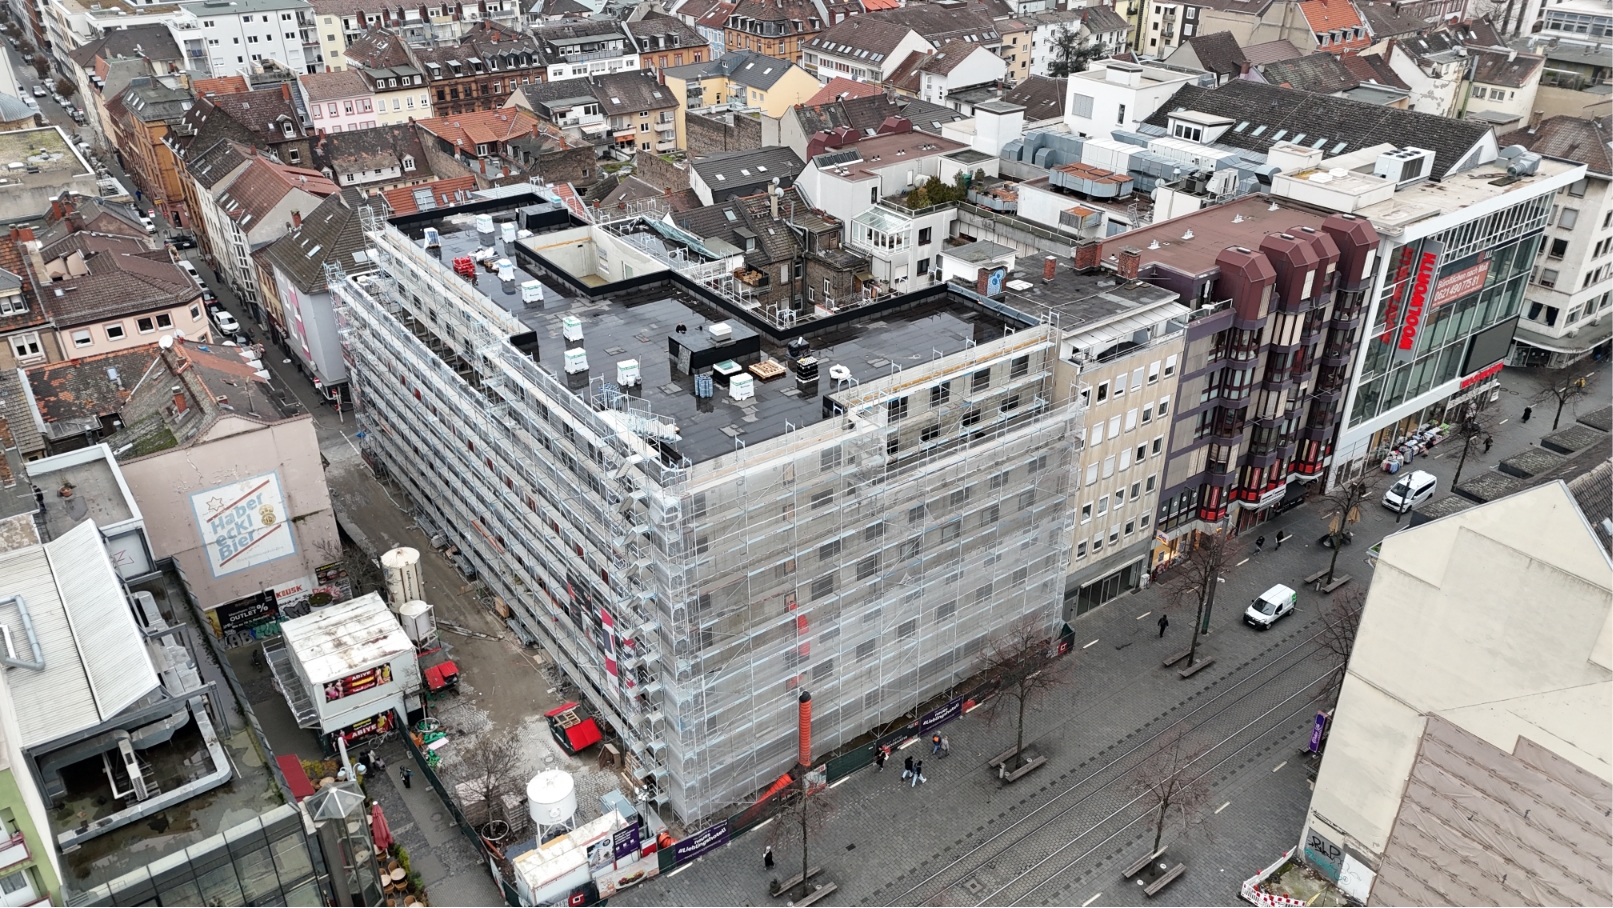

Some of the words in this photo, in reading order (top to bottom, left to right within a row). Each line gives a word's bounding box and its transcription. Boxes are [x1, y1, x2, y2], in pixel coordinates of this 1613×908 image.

[1399, 252, 1437, 350] WOOLWORTH
[211, 492, 263, 535] Haber
[216, 513, 253, 547] eckl
[219, 531, 255, 561] Bier
[230, 609, 257, 622] OUTLET
[352, 723, 377, 738] ABIYE
[678, 827, 727, 854] #Lieblingshotel!
